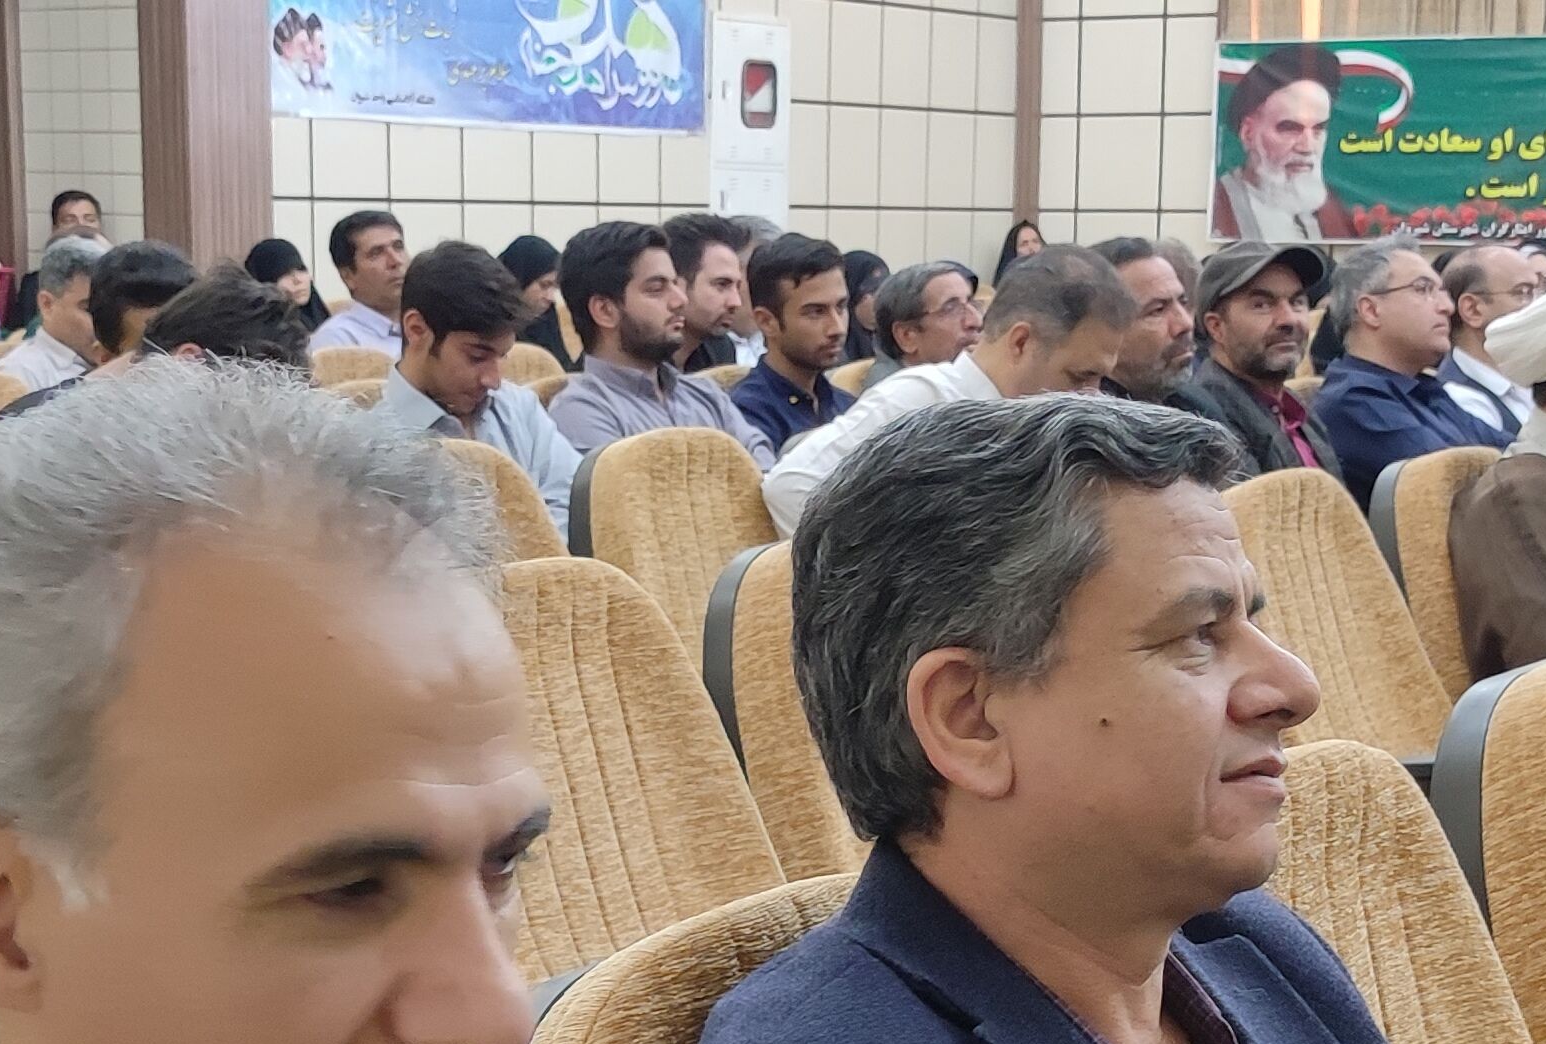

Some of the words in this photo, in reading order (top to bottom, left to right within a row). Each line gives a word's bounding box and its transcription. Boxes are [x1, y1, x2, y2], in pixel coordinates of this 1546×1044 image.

[1339, 126, 1394, 154] است
[1397, 126, 1483, 154] سعادت
[1486, 126, 1514, 161] او
